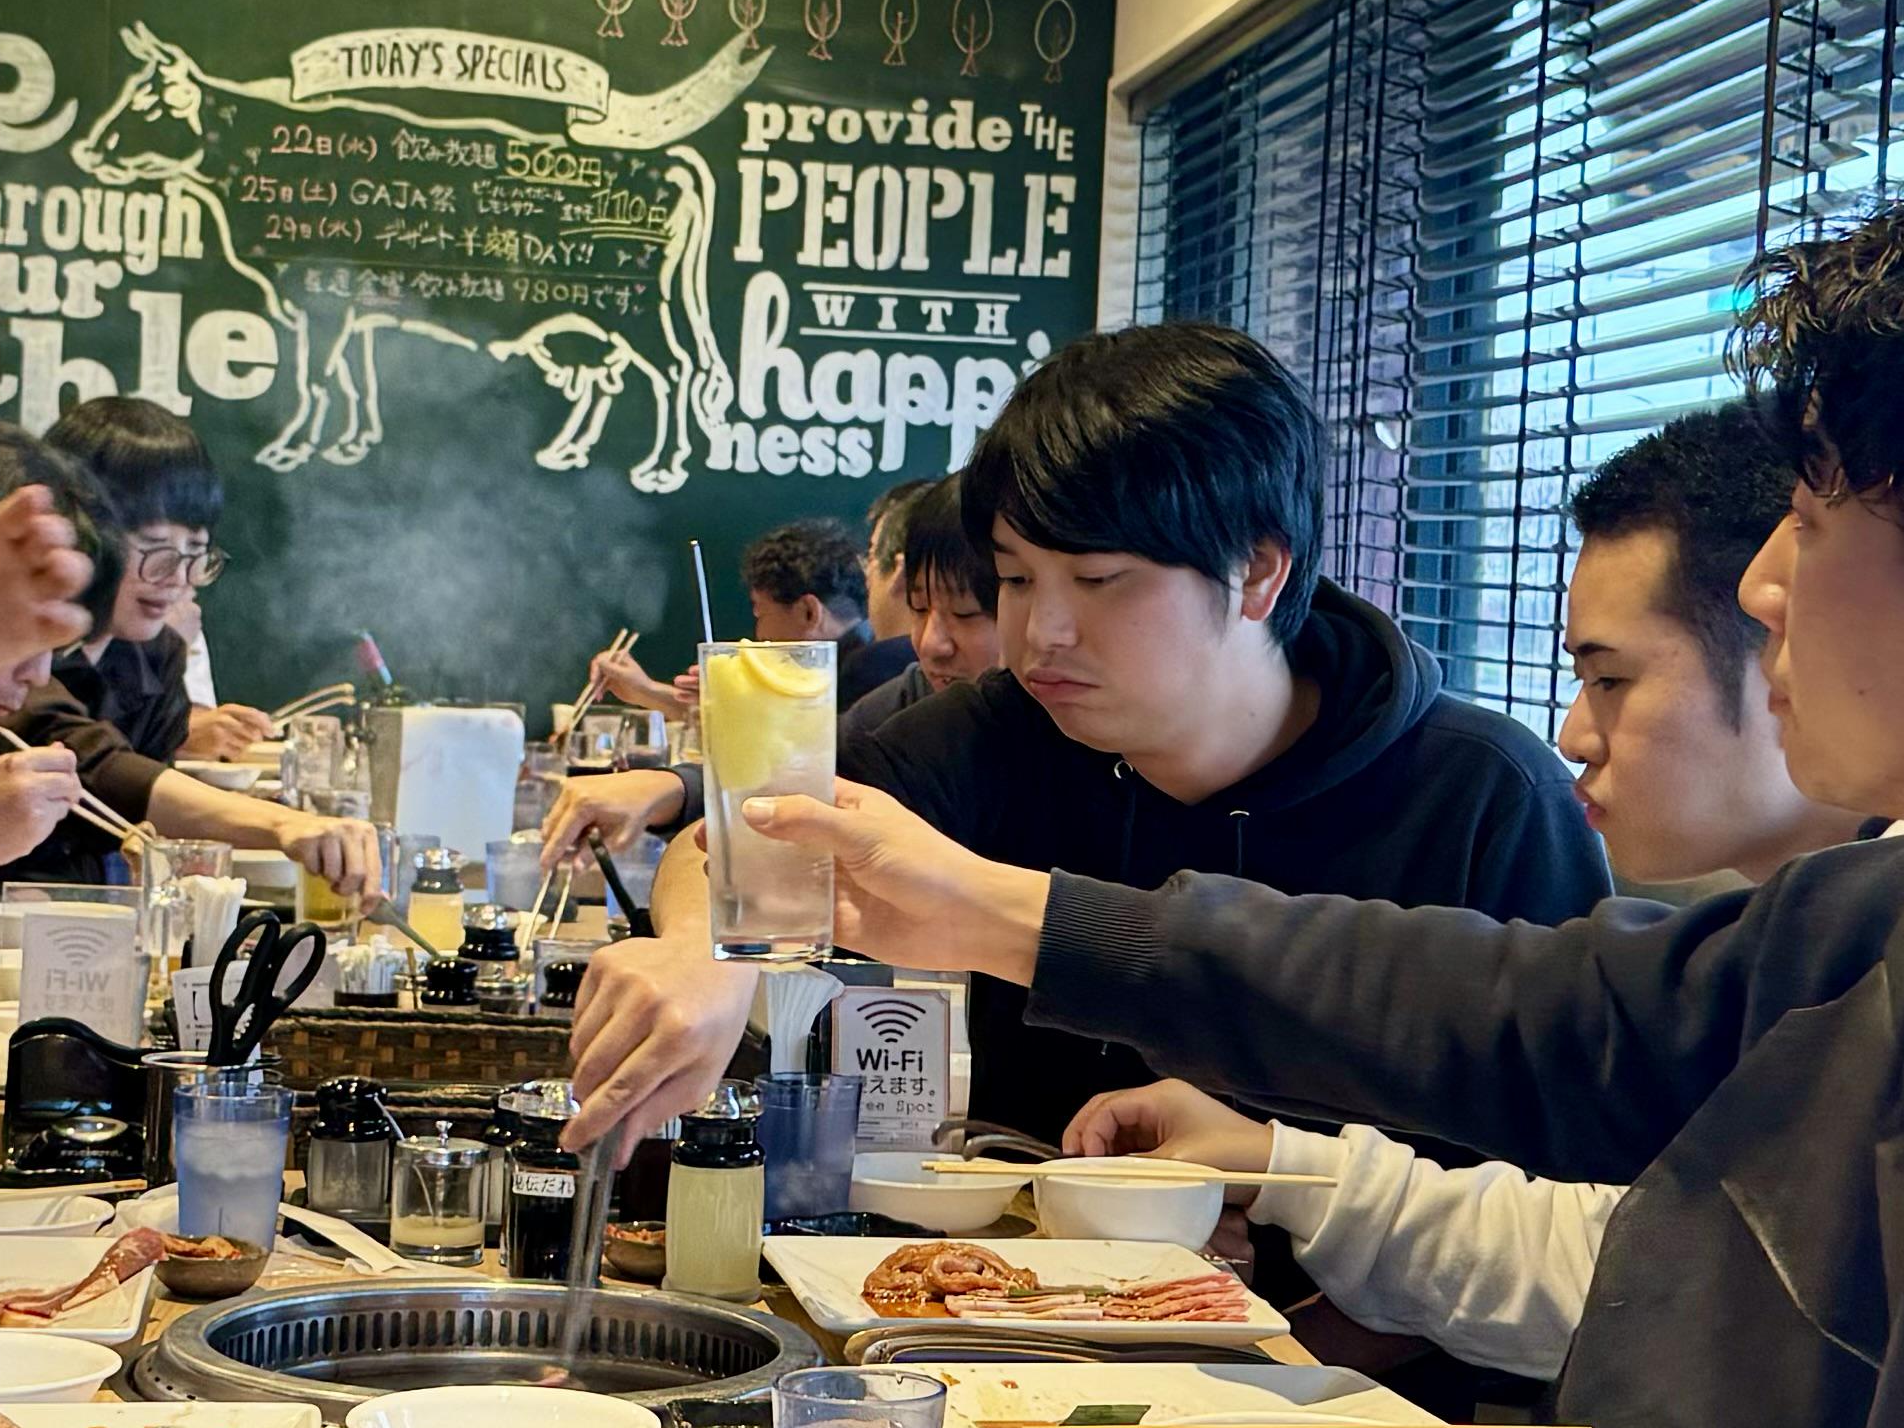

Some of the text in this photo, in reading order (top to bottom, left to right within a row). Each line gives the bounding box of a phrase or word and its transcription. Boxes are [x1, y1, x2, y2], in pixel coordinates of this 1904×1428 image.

[339, 41, 567, 93] TODAY'S SPECIALS
[742, 99, 1075, 162] provide THE
[732, 157, 1077, 279] PEOPLE
[813, 291, 1011, 337] WITH
[705, 421, 877, 479] ness
[856, 1047, 924, 1073] Wi-Fi
